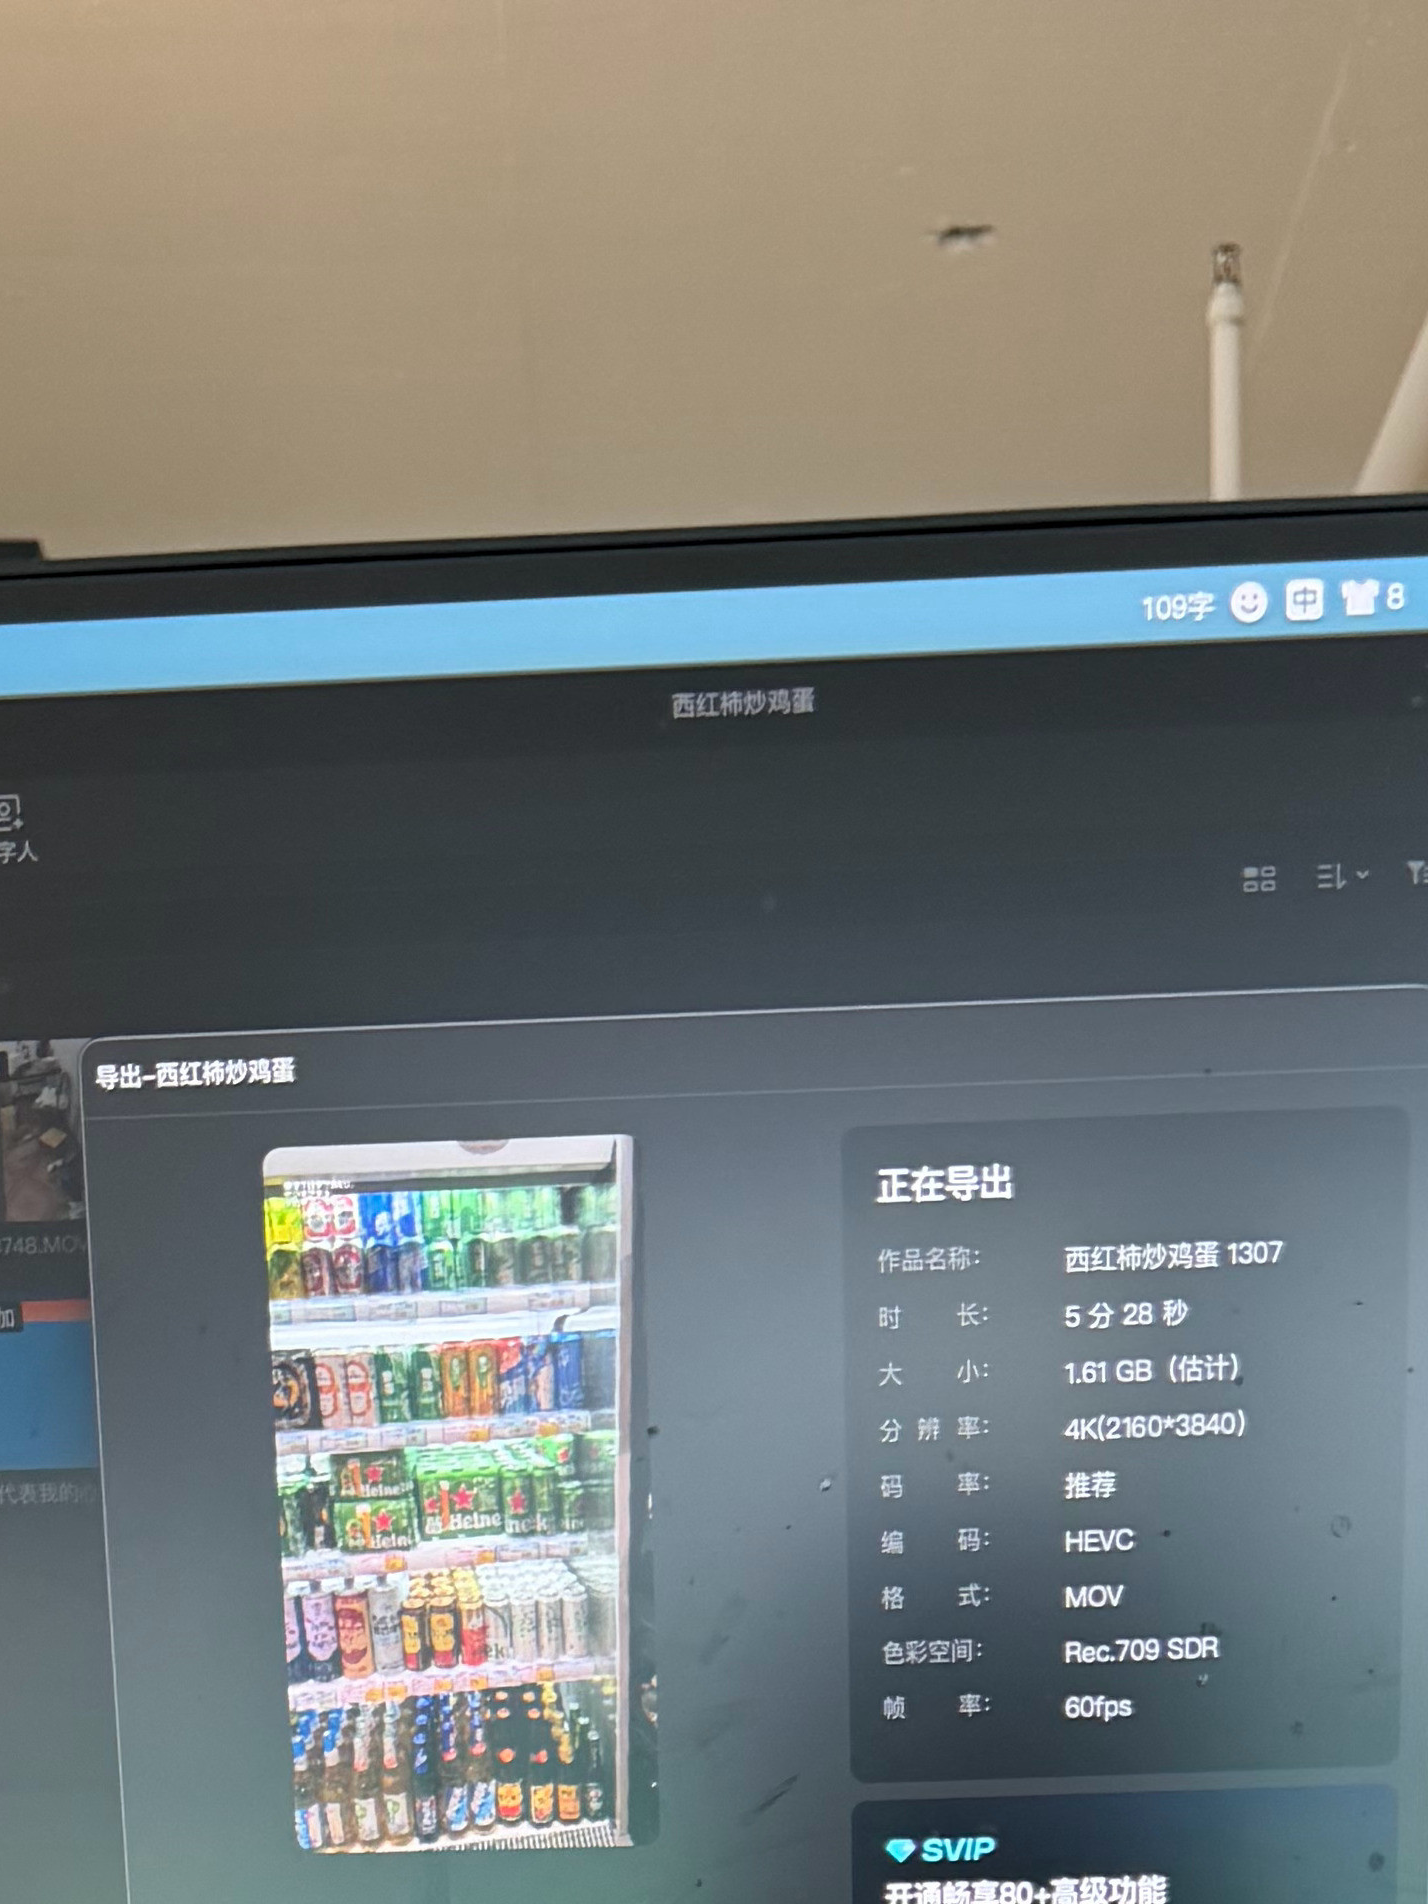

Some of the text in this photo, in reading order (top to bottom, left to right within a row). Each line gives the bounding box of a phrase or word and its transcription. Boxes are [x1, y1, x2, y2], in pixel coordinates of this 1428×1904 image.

[1142, 591, 1215, 622] 109字
[1386, 583, 1405, 611] 8
[672, 687, 815, 719] 西红柿炒鸡蛋
[876, 1163, 1014, 1204] 正在导出
[1064, 1240, 1283, 1274] 西红柿炒鸡蛋 1307
[1064, 1299, 1189, 1328] 5 分 28 秒
[1064, 1358, 1153, 1385] 1.61 GB
[1064, 1470, 1117, 1500] 推荐
[1064, 1528, 1135, 1554] HEVC
[1064, 1585, 1125, 1609] MOV
[1064, 1636, 1220, 1664] Rec.709 SDR
[1065, 1694, 1134, 1722] 60fps
[921, 1836, 996, 1863] SVIP
